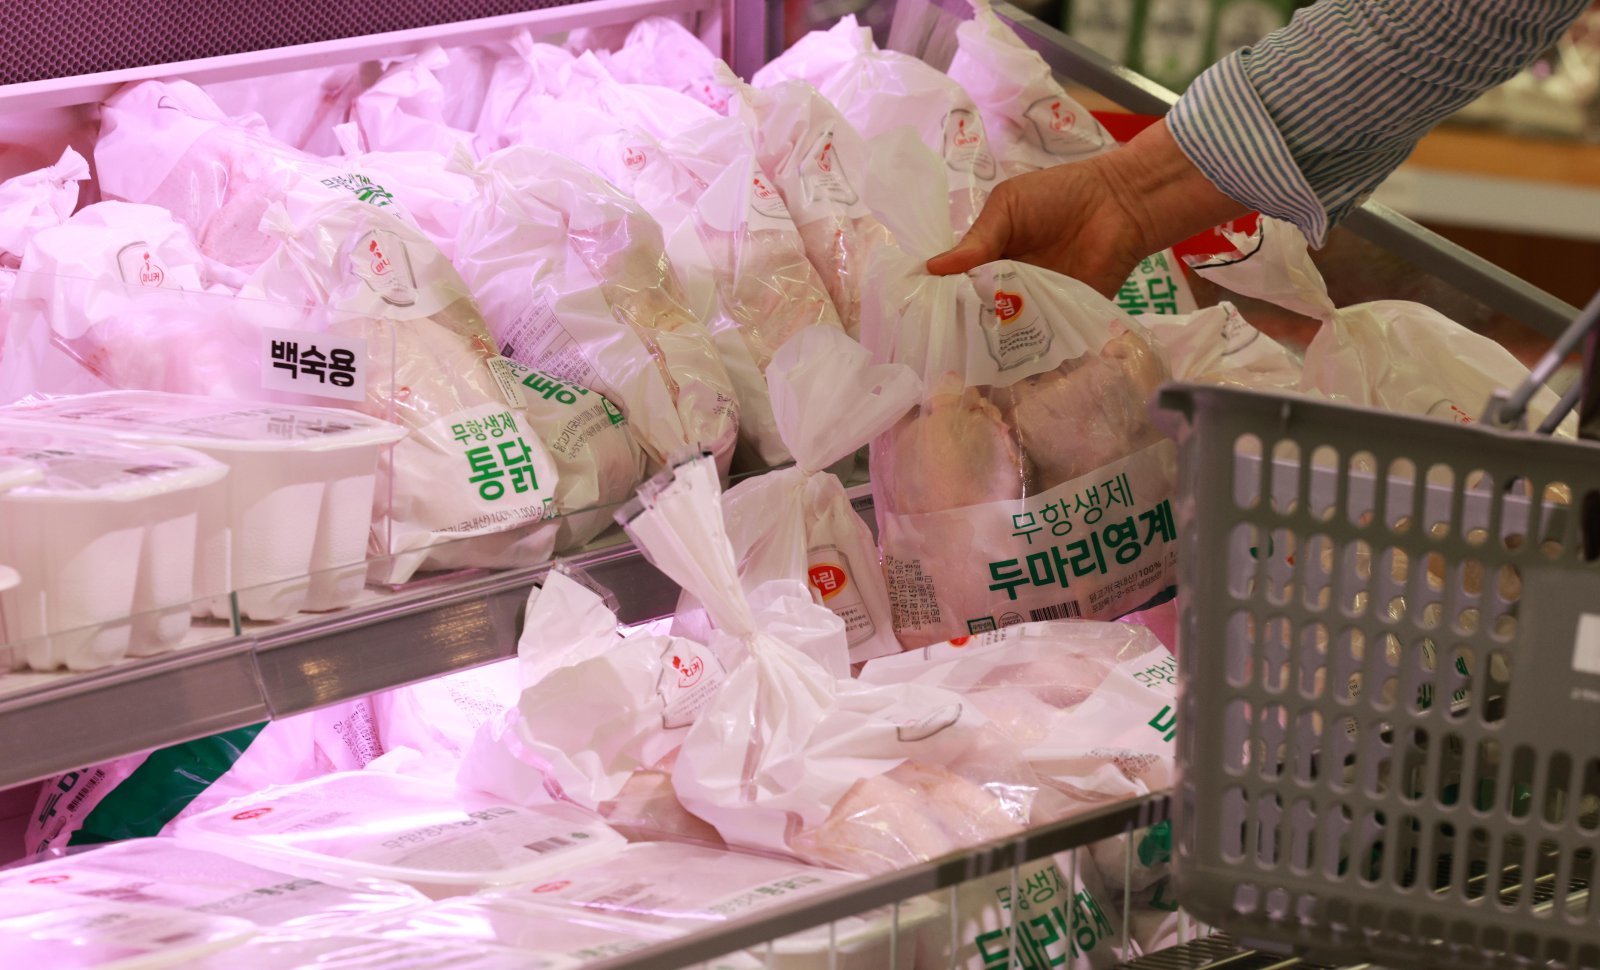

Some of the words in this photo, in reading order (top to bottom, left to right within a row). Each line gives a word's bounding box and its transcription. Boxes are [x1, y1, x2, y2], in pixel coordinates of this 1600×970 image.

[271, 340, 356, 387] 백숙용
[450, 411, 519, 445] 무항생제
[464, 436, 539, 501] 통닭
[1012, 473, 1134, 544] 무항생제
[989, 499, 1177, 600] 두마리영계
[1138, 560, 1162, 577] 100%
